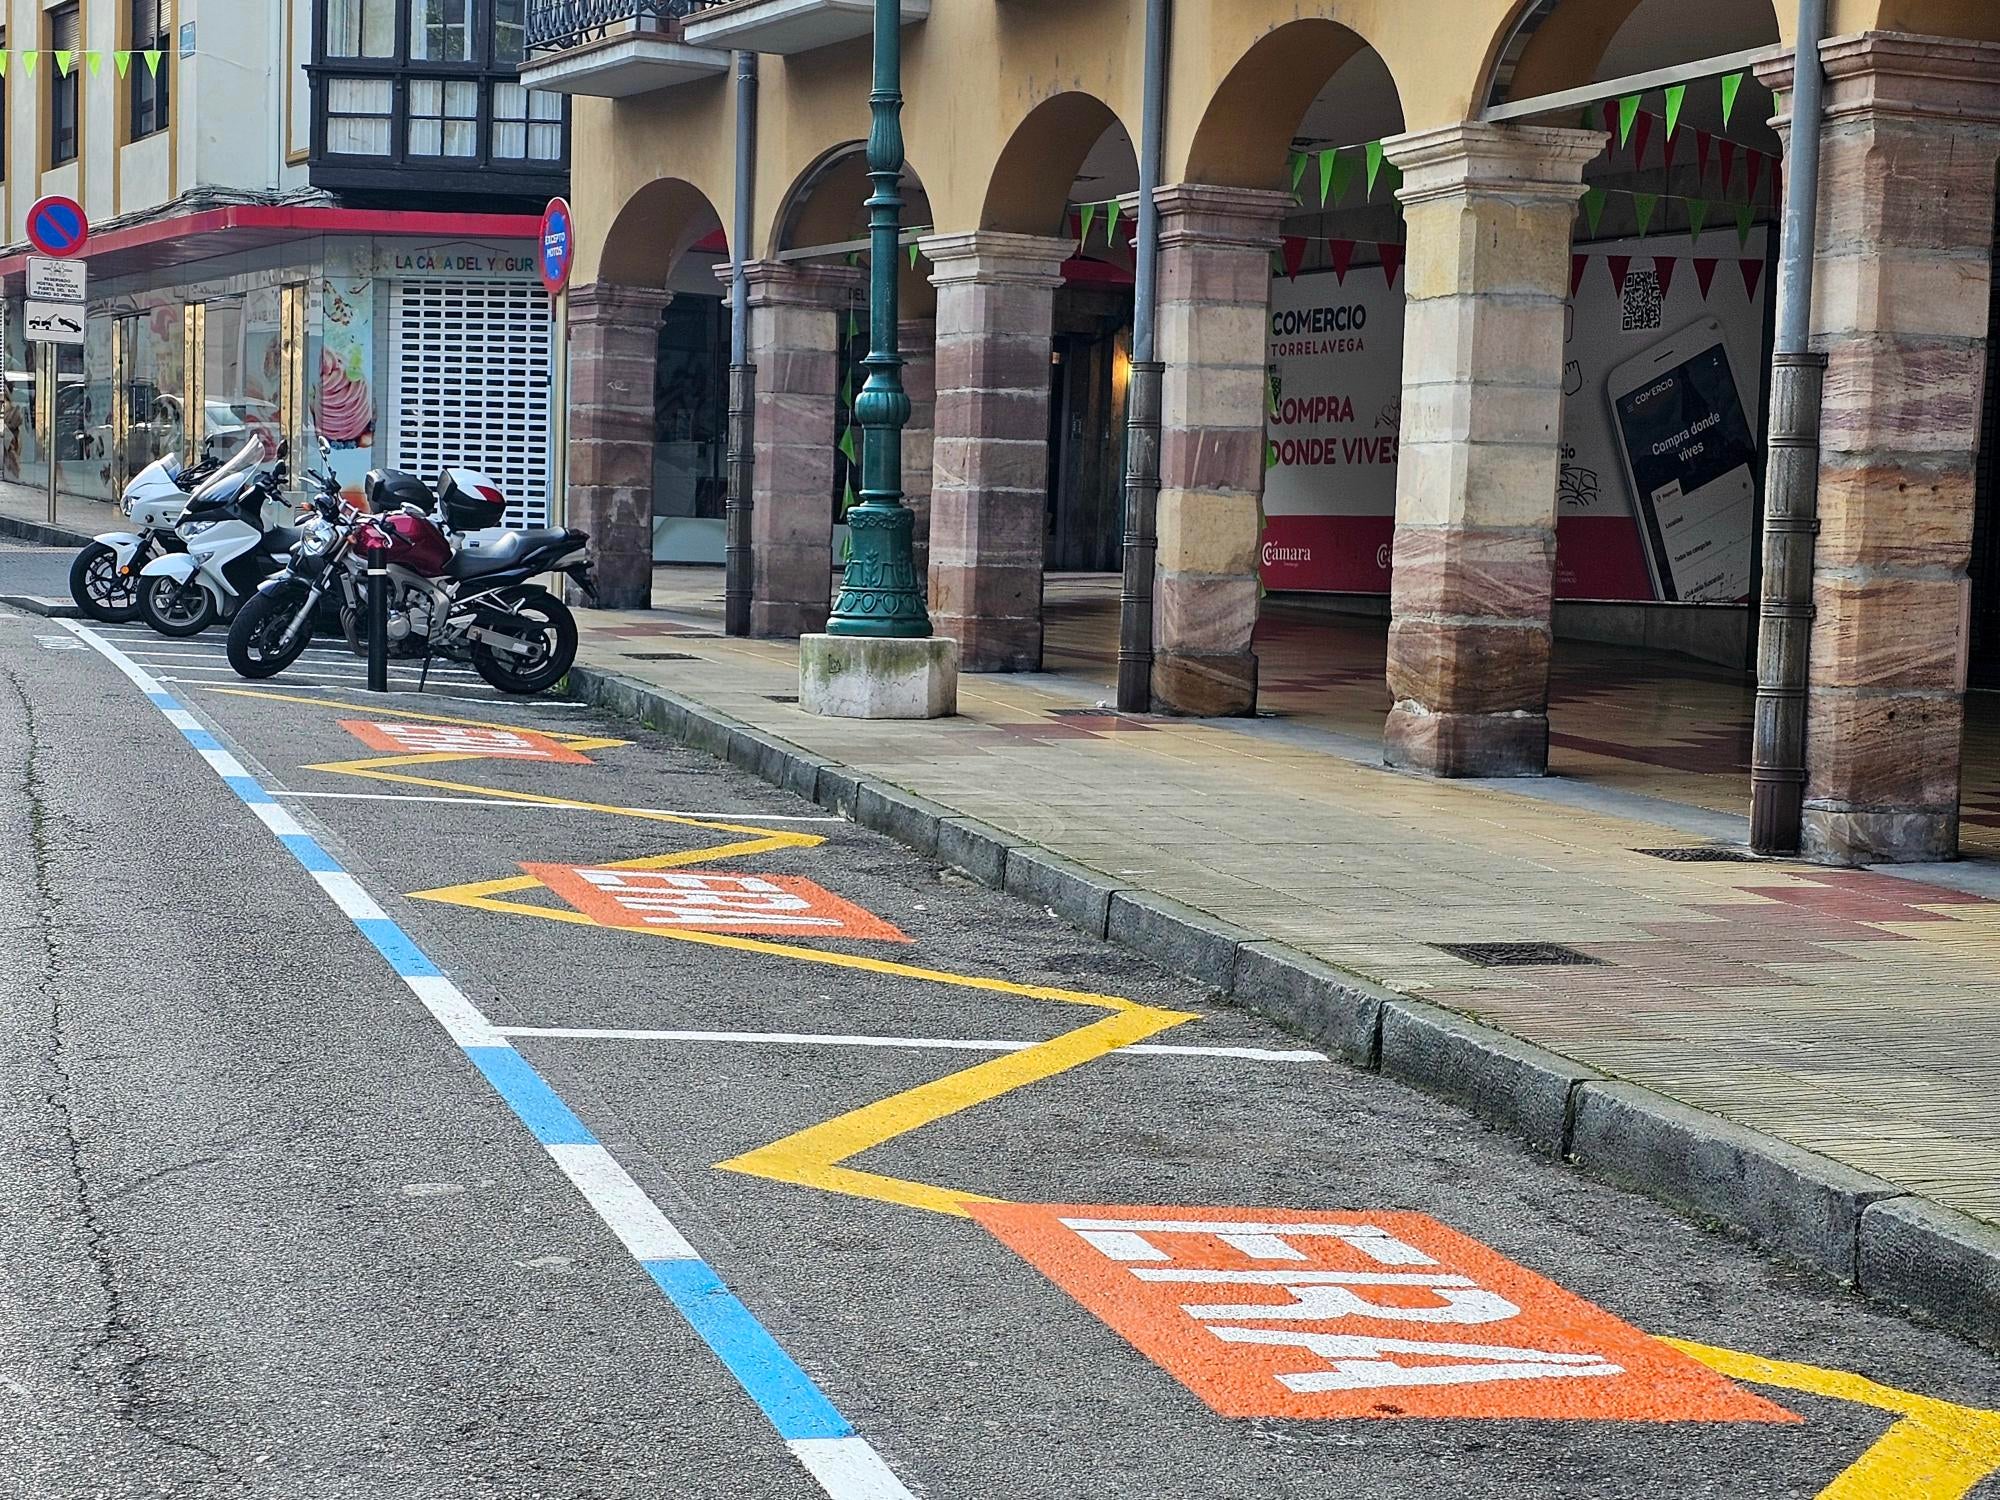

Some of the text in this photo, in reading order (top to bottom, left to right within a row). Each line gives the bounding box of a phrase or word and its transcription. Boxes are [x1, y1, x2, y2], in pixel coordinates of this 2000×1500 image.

[396, 256, 534, 272] LA CASA DEL YOGUR
[547, 246, 563, 258] MOTOS
[1272, 304, 1367, 336] COMERCIO
[1271, 338, 1365, 357] TORRELAVEGA
[1634, 378, 1674, 405] COMERCIO
[1652, 412, 1721, 456] Compra donde
[1268, 438, 1337, 466] DONDE
[1678, 442, 1704, 463] vives
[1262, 540, 1311, 566] Cámara
[373, 723, 555, 757] ERA
[572, 868, 845, 928] ERA
[1059, 1217, 1625, 1394] ERA
